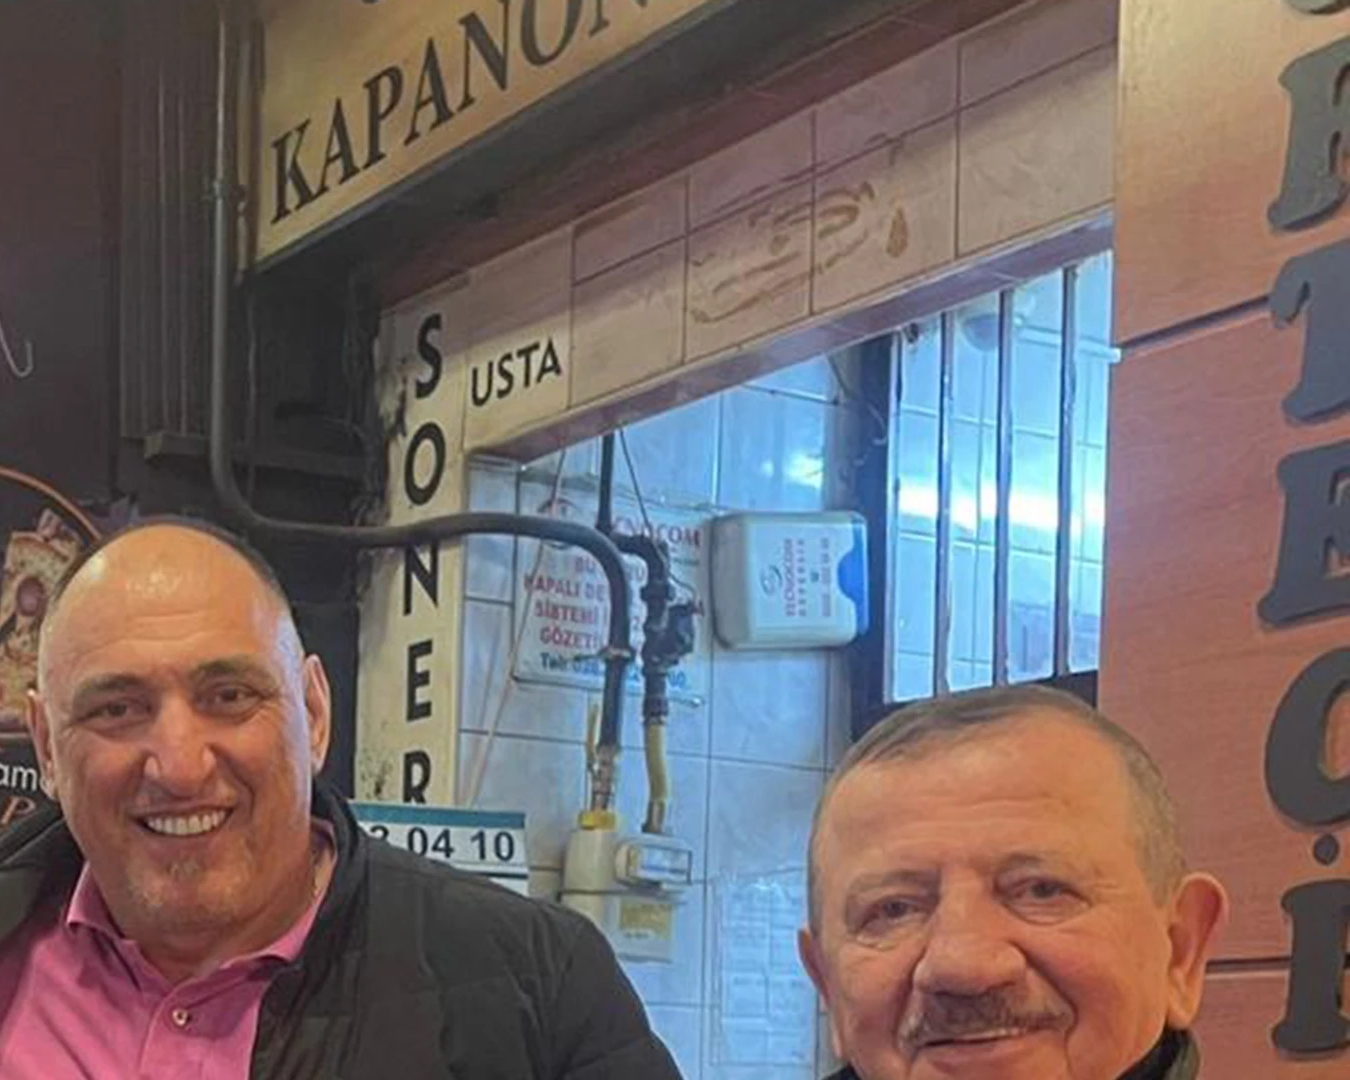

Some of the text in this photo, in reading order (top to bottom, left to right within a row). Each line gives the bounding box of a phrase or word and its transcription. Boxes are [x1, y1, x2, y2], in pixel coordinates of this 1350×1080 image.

[471, 337, 562, 407] USTA
[402, 313, 447, 804] SONER
[470, 831, 515, 861] 10
